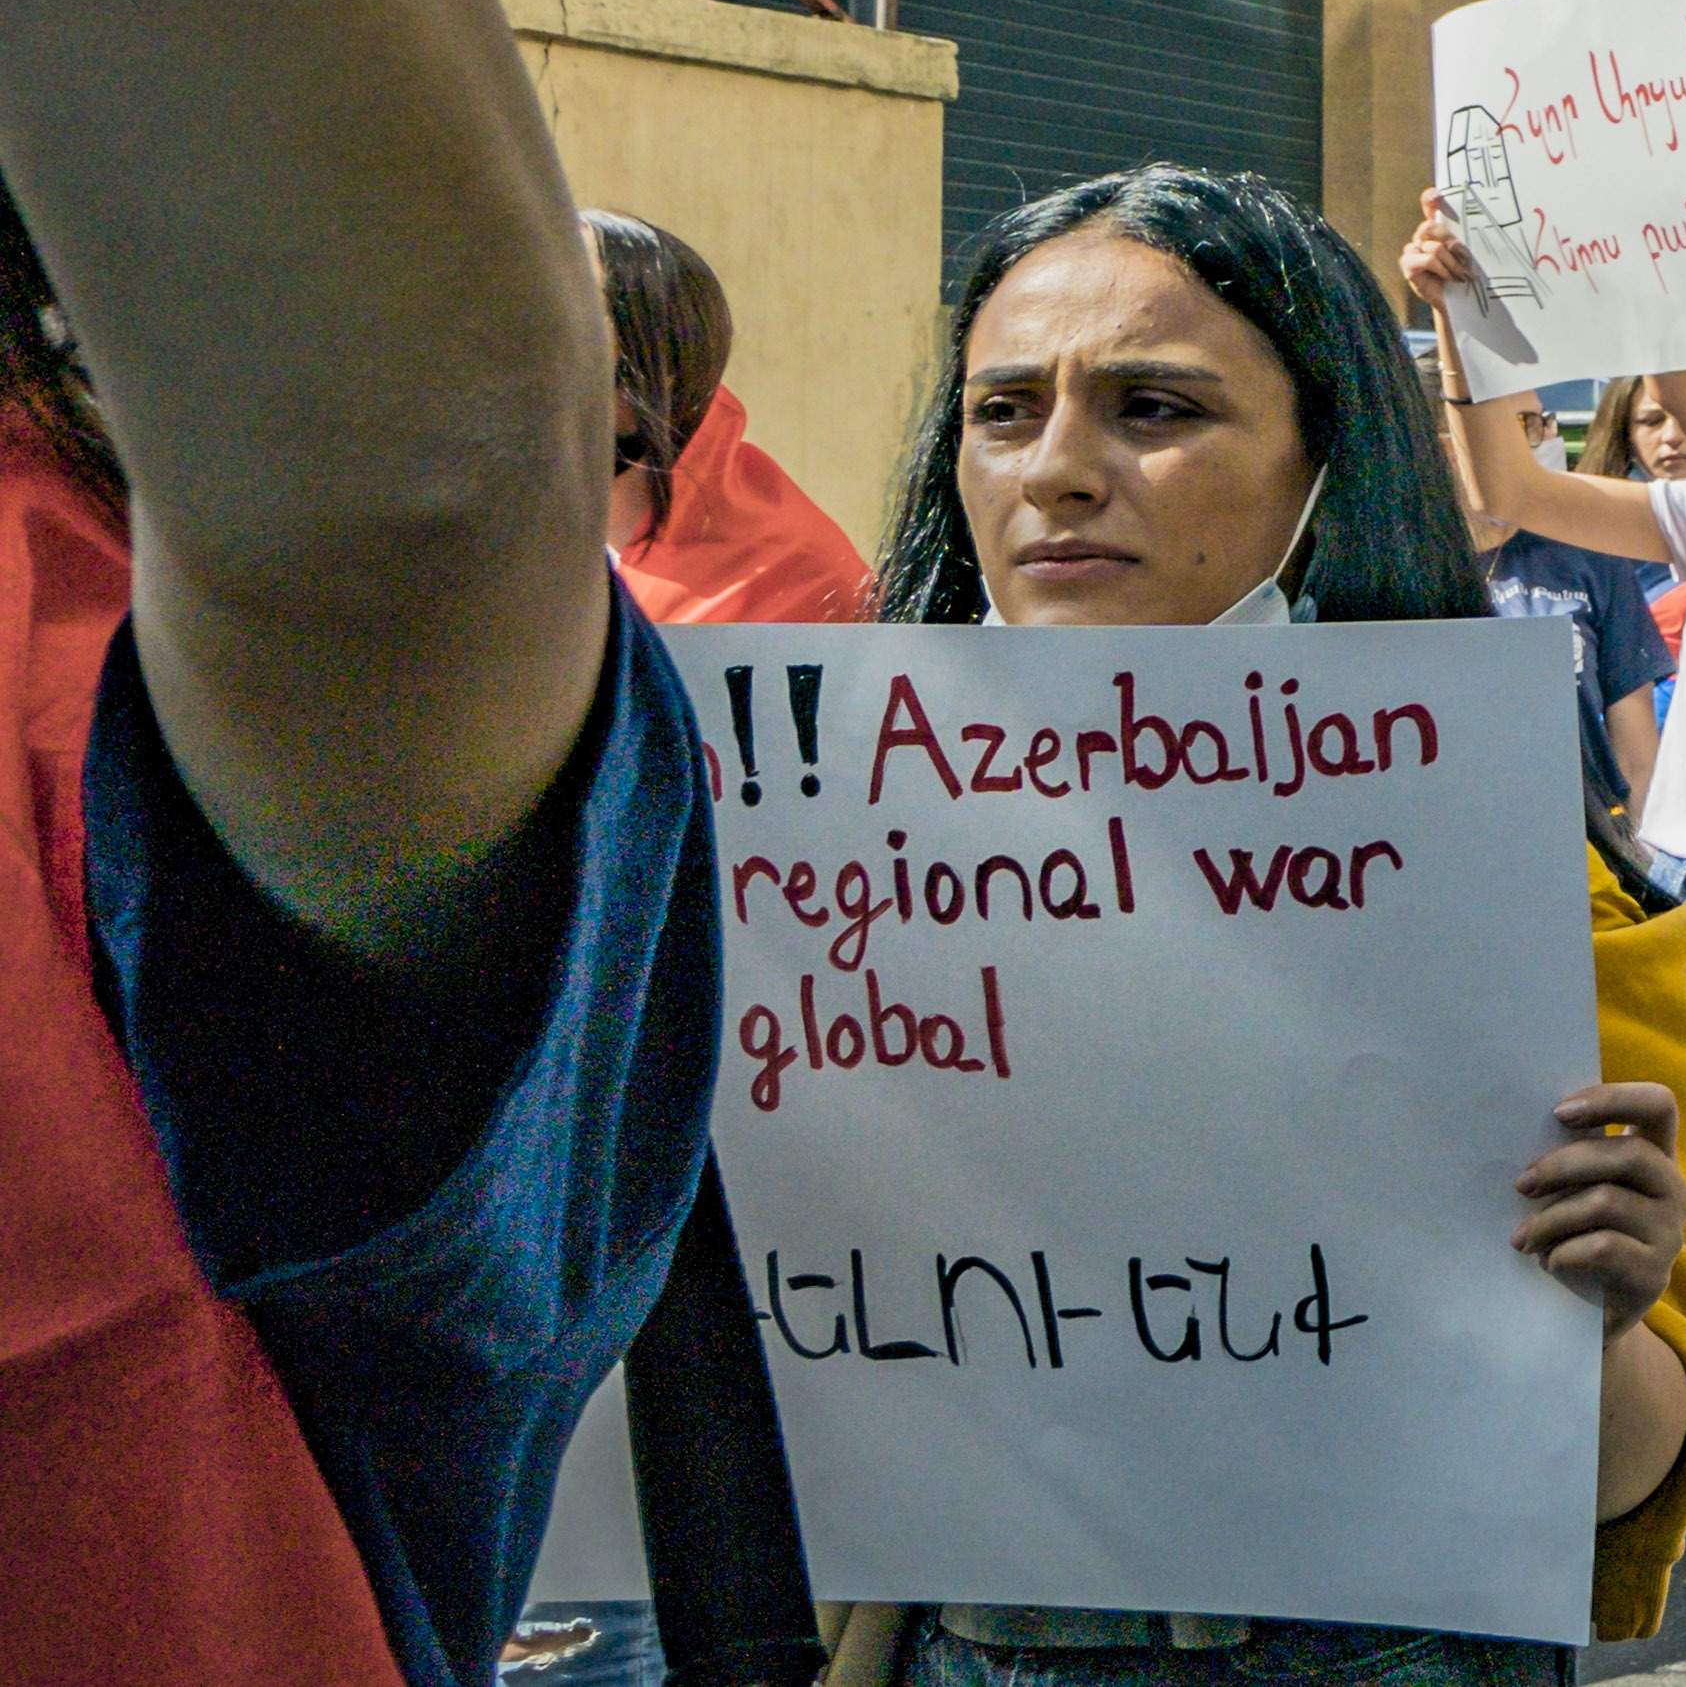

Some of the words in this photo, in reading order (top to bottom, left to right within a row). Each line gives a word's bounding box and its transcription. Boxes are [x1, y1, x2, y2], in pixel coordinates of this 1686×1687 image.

[869, 671, 1438, 805] Azerbaijan
[733, 817, 1134, 969] regional
[1193, 841, 1402, 914] war
[740, 966, 1010, 1112] global
